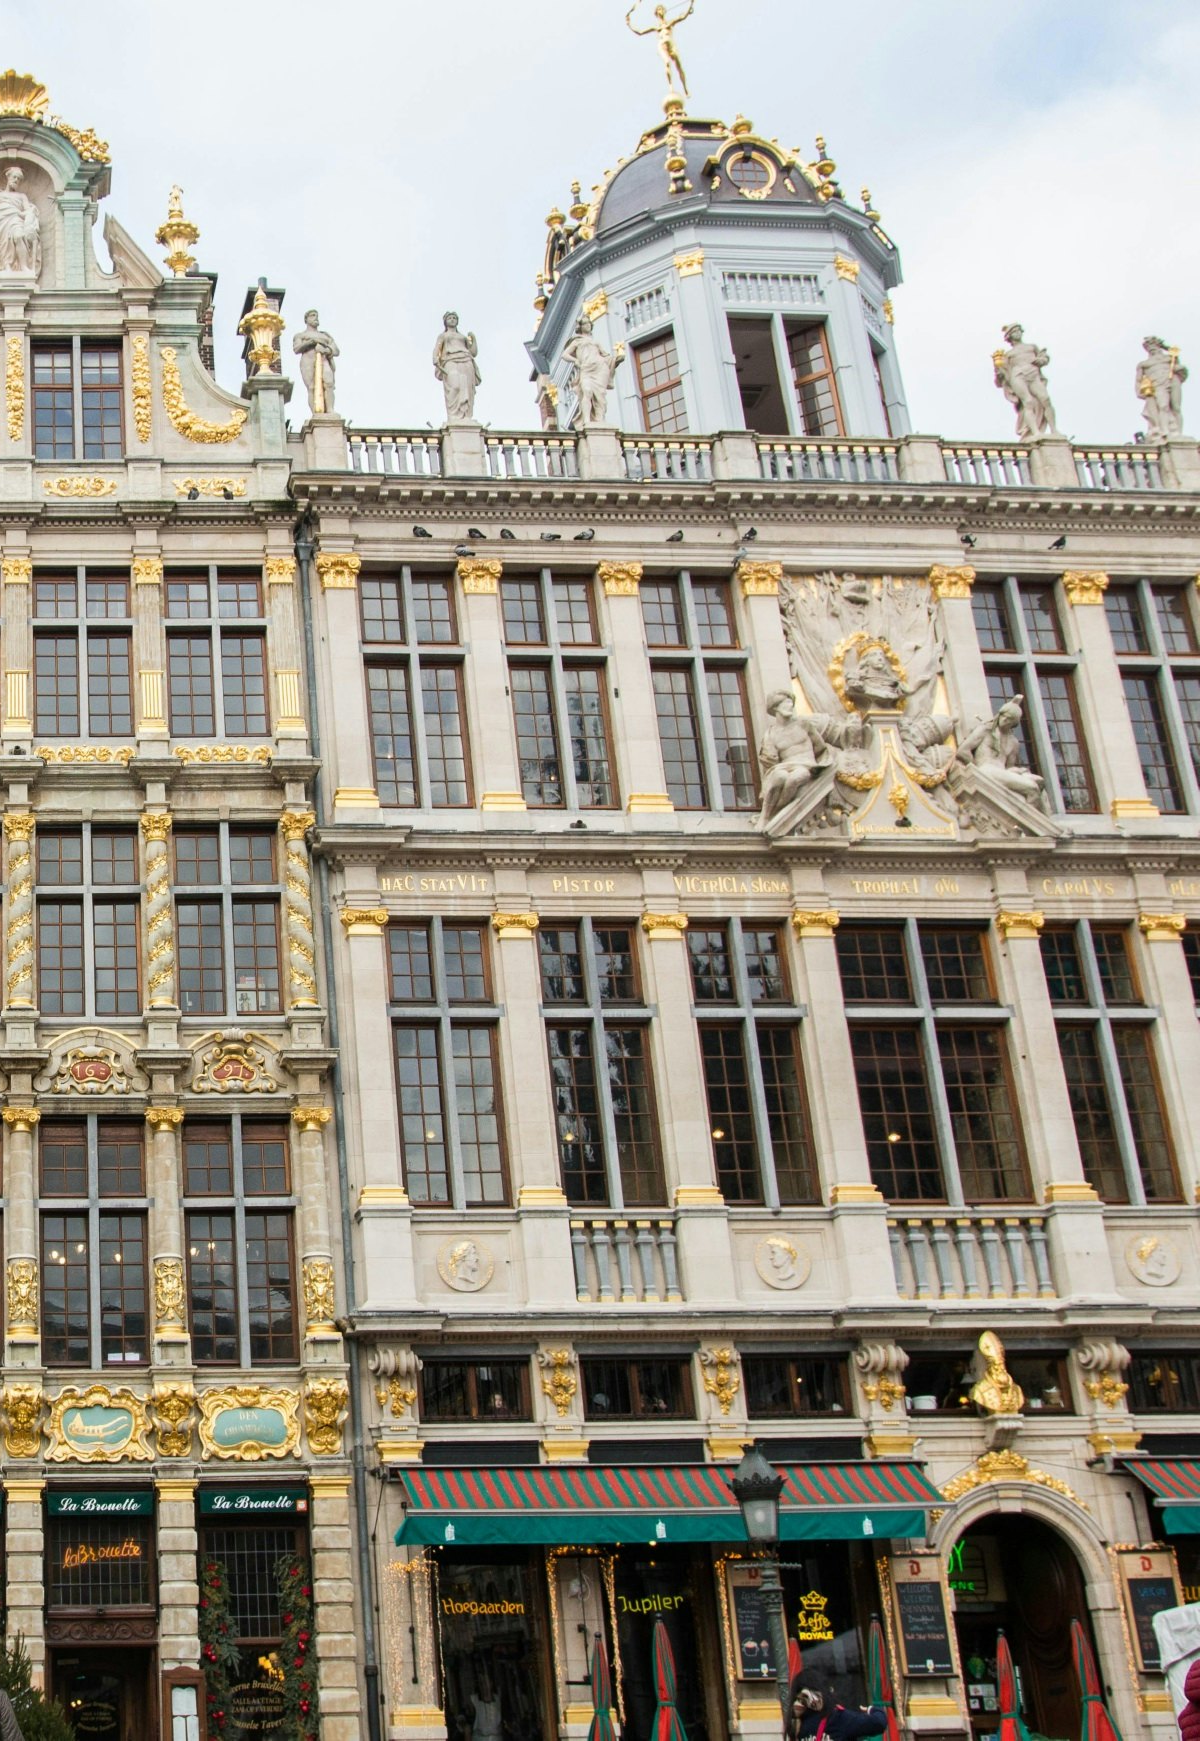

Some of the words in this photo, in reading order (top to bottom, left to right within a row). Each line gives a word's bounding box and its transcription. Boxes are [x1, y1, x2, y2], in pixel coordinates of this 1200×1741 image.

[420, 875, 488, 891] STATVIT
[552, 876, 616, 892] PISTOR
[673, 876, 748, 893] VICTRICIA
[750, 877, 789, 893] SIGNA
[1042, 878, 1115, 896] CAROLVS
[58, 1498, 80, 1511] La
[80, 1498, 141, 1511] Brouette
[212, 1496, 233, 1509] La
[234, 1496, 294, 1509] Brouette
[442, 1598, 525, 1616] Hoegaarden
[617, 1595, 684, 1614] Jupiler
[798, 1611, 831, 1632] Leffe
[799, 1631, 834, 1640] ROYALE
